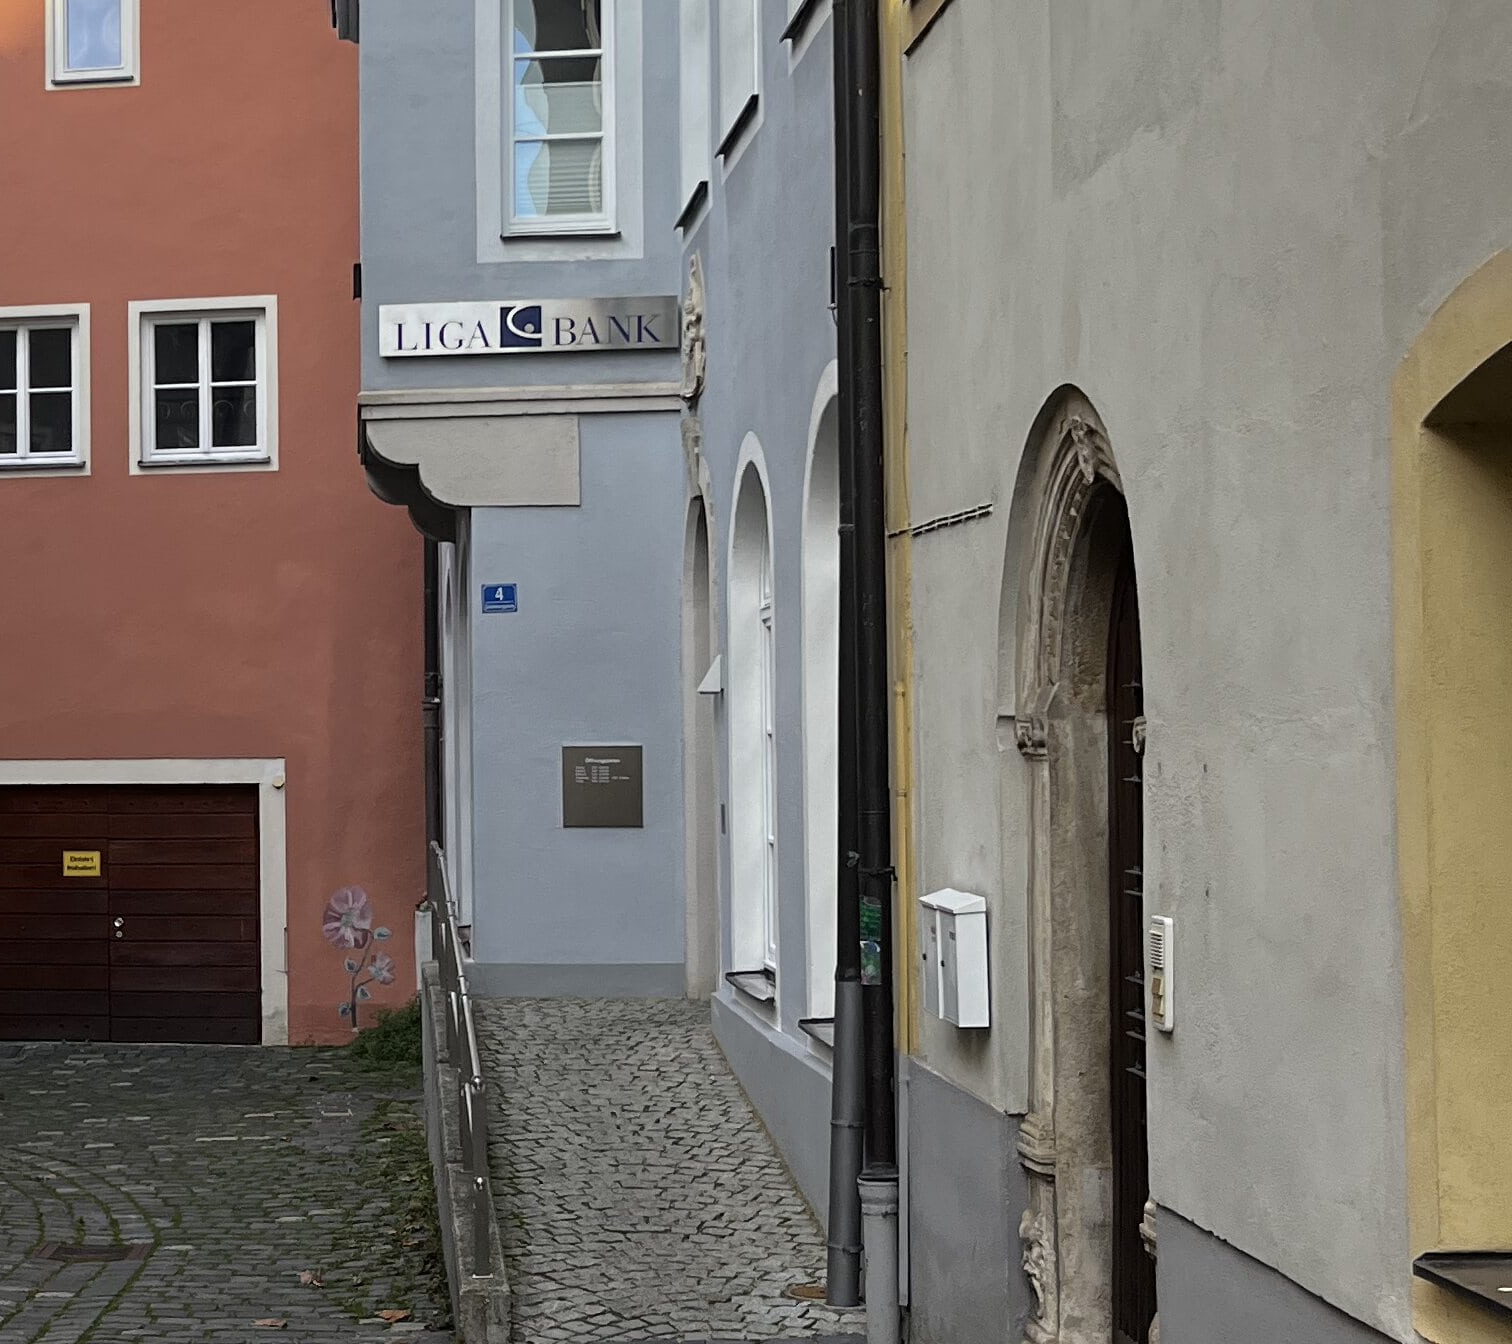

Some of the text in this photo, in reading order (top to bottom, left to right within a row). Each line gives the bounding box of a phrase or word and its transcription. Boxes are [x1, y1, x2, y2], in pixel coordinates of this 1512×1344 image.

[394, 314, 661, 351] LIGA BANK
[494, 587, 504, 601] 4
